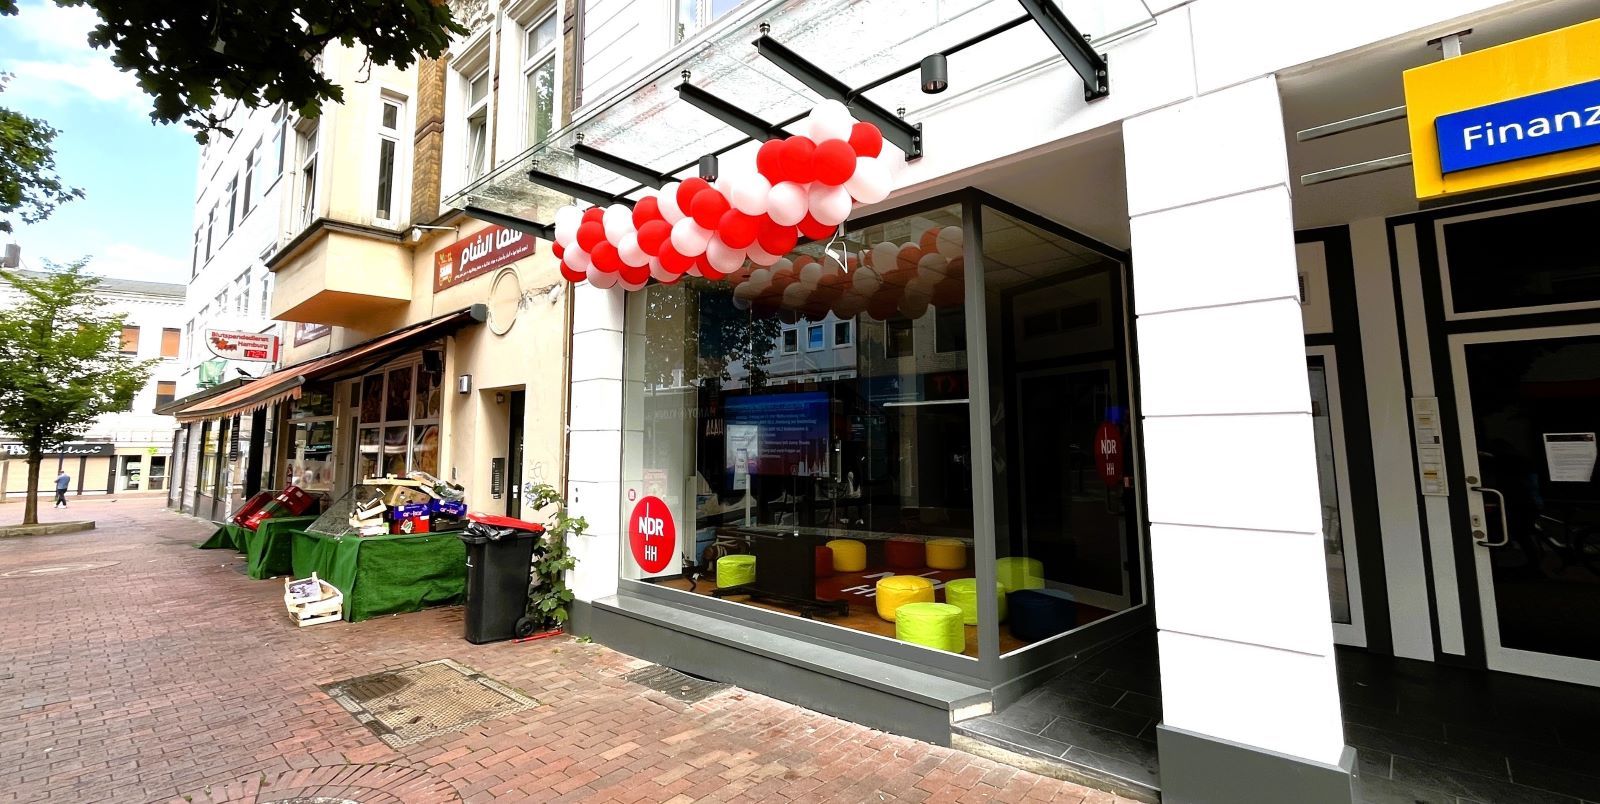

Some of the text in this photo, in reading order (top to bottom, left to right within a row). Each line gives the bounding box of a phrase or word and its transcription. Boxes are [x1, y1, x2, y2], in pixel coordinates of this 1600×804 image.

[1463, 106, 1600, 151] Finanz
[459, 233, 493, 272] الشام
[211, 331, 269, 343] Blutspendedienst
[237, 341, 268, 350] Hamburg
[1100, 439, 1117, 455] NDR
[1106, 463, 1115, 476] HH
[638, 516, 664, 537] NDR
[645, 544, 657, 562] HH
